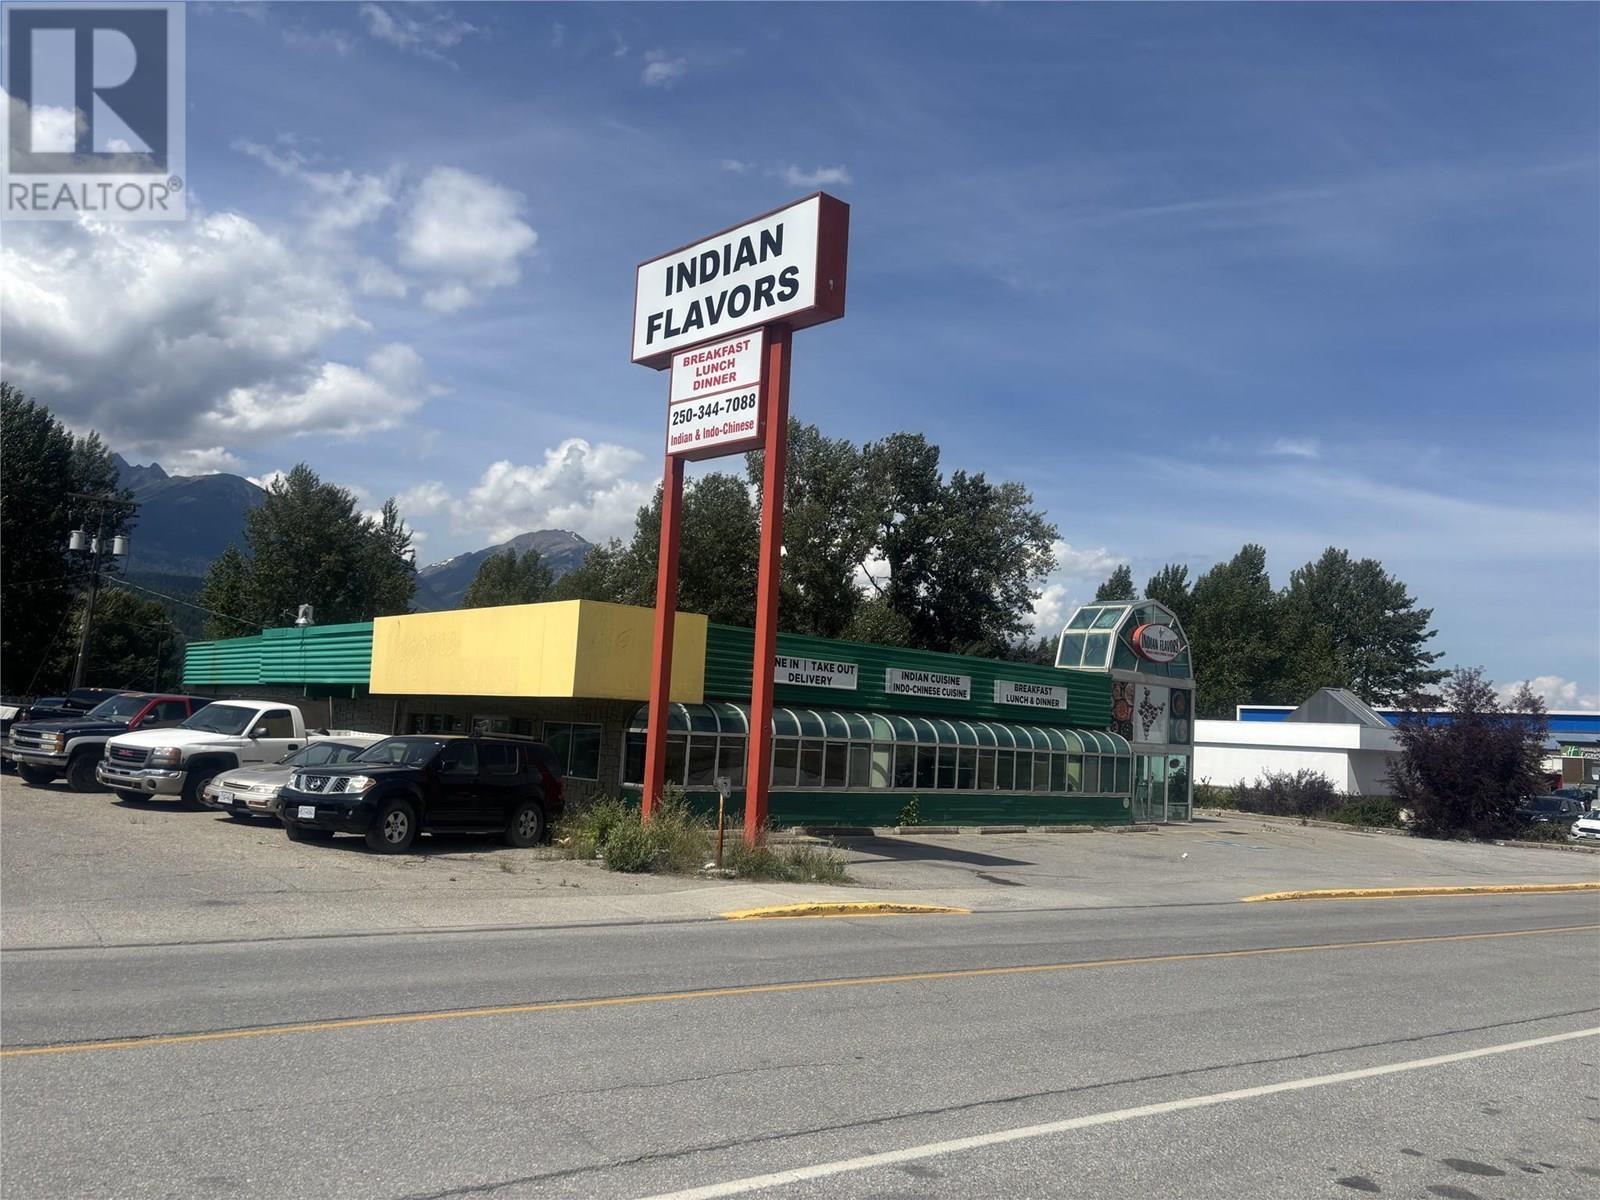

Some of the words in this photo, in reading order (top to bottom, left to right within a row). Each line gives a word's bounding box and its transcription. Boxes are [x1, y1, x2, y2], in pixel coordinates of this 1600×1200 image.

[665, 223, 784, 297] INDIAN
[646, 265, 800, 345] FLAVORS
[683, 340, 751, 367] BREAKFAST
[696, 358, 736, 377] LUNCH
[693, 372, 737, 391] DINNER
[672, 393, 756, 426] 250-344-7088
[670, 432, 693, 446] Indian
[695, 429, 701, 441] &
[703, 420, 754, 439] Indo-Chinese
[1142, 634, 1159, 650] INDIAN
[775, 658, 787, 668] NE
[789, 659, 799, 669] IN
[811, 661, 835, 673] TAKE
[837, 665, 855, 674] OUT
[788, 673, 833, 685] DELIVERY
[901, 671, 929, 682] INDIAN
[930, 674, 961, 685] CUISINE
[893, 683, 941, 695] INDO-CHINESE
[942, 688, 967, 698] CUISINE
[1014, 684, 1053, 695] BREAKFAST
[1006, 694, 1029, 704] LUNCH
[1029, 697, 1034, 705] &
[1035, 698, 1060, 707] DINNER
